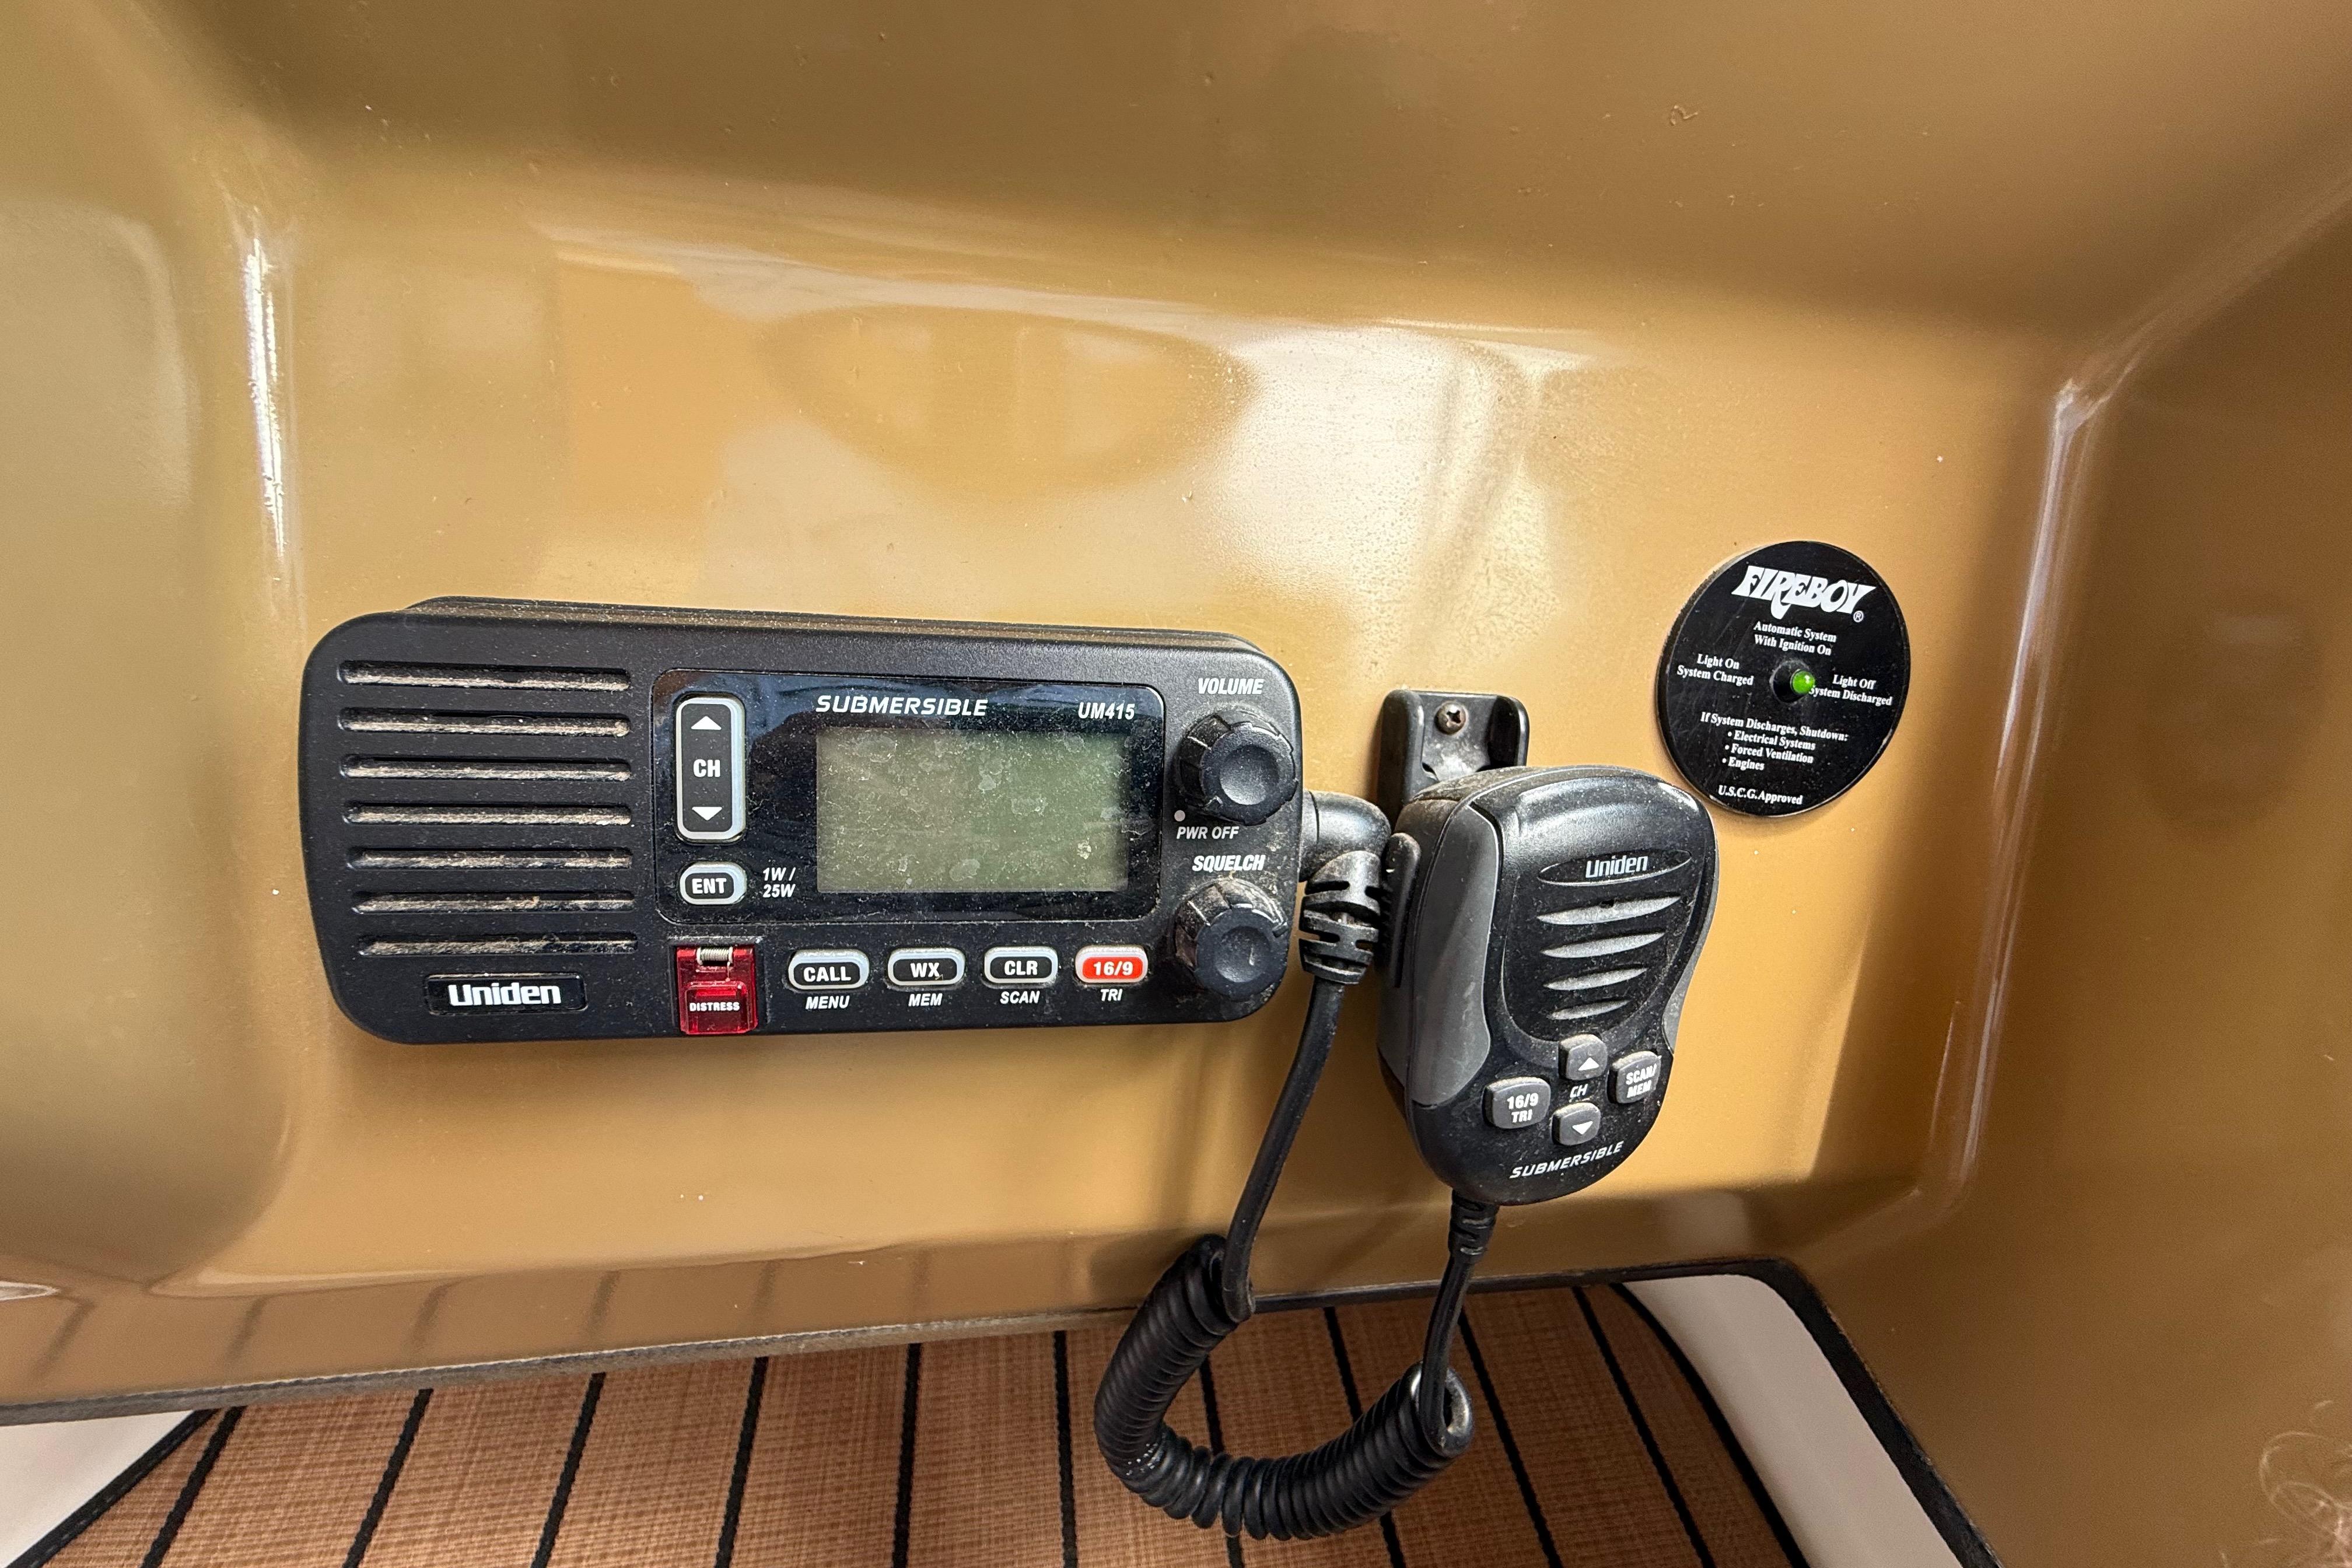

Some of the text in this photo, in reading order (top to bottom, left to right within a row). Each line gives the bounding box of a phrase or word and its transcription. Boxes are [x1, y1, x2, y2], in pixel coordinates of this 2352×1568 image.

[1754, 621, 1836, 642] Automatic System
[1754, 634, 1832, 656] With Ignition On
[1697, 654, 1740, 670] Light On
[1677, 665, 1754, 686] System Charged
[1833, 674, 1876, 690] Light Off
[1198, 678, 1264, 695] VOLUME
[1809, 685, 1892, 706] System Discharged
[817, 695, 988, 716] SUBMERSIBLE
[1077, 702, 1135, 720] UM415
[1700, 712, 1848, 741] If System Discharges, Shutdown:
[1734, 730, 1815, 751] Electrical Systems
[1731, 743, 1814, 764] Forced Ventilation
[693, 760, 720, 778] CH
[1728, 757, 1765, 772] Engines
[1177, 827, 1239, 839] PWR OFF
[1192, 855, 1265, 872] SQUELCH
[1586, 854, 1648, 878] Uniden
[691, 877, 727, 895] ENT
[762, 884, 796, 898] 25W
[803, 965, 852, 984] CALL
[911, 961, 940, 978] WX
[1005, 960, 1038, 975] CLR
[1093, 960, 1134, 977] 16/9
[448, 982, 561, 1006] Uniden
[806, 996, 850, 1009] MENU
[908, 993, 943, 1007] MEM
[1000, 990, 1040, 1004] SCAN
[1100, 989, 1122, 1001] TRI
[690, 1002, 740, 1012] DISTRESS
[1626, 1063, 1657, 1084] SCAN/
[1570, 1084, 1587, 1097] CH
[1627, 1079, 1652, 1098] MEM
[1507, 1093, 1539, 1109] 16/9
[1511, 1108, 1532, 1123] TRI
[1510, 1140, 1625, 1179] SUBMERSIBLE
